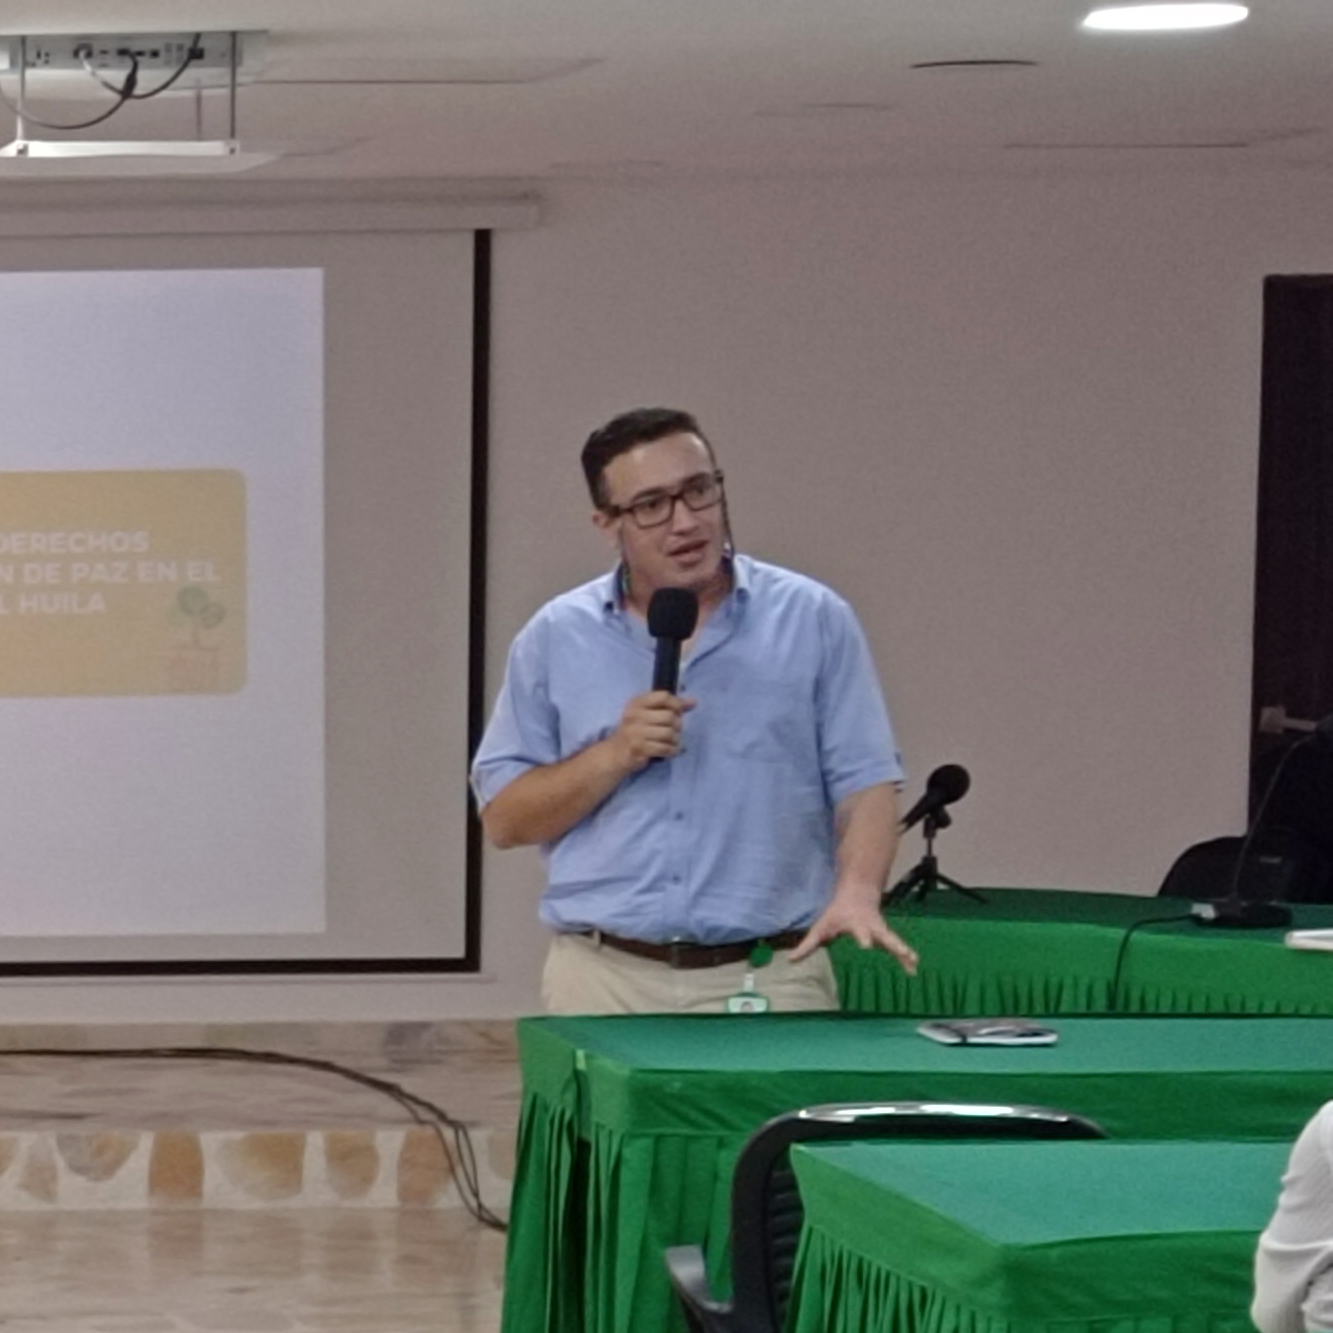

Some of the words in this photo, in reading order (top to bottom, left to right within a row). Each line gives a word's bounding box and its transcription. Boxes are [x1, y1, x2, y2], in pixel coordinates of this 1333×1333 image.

[23, 562, 62, 585] DE
[71, 561, 130, 584] PAZ
[137, 560, 178, 583] EN
[186, 559, 221, 583] EL
[20, 592, 107, 615] HUILA
